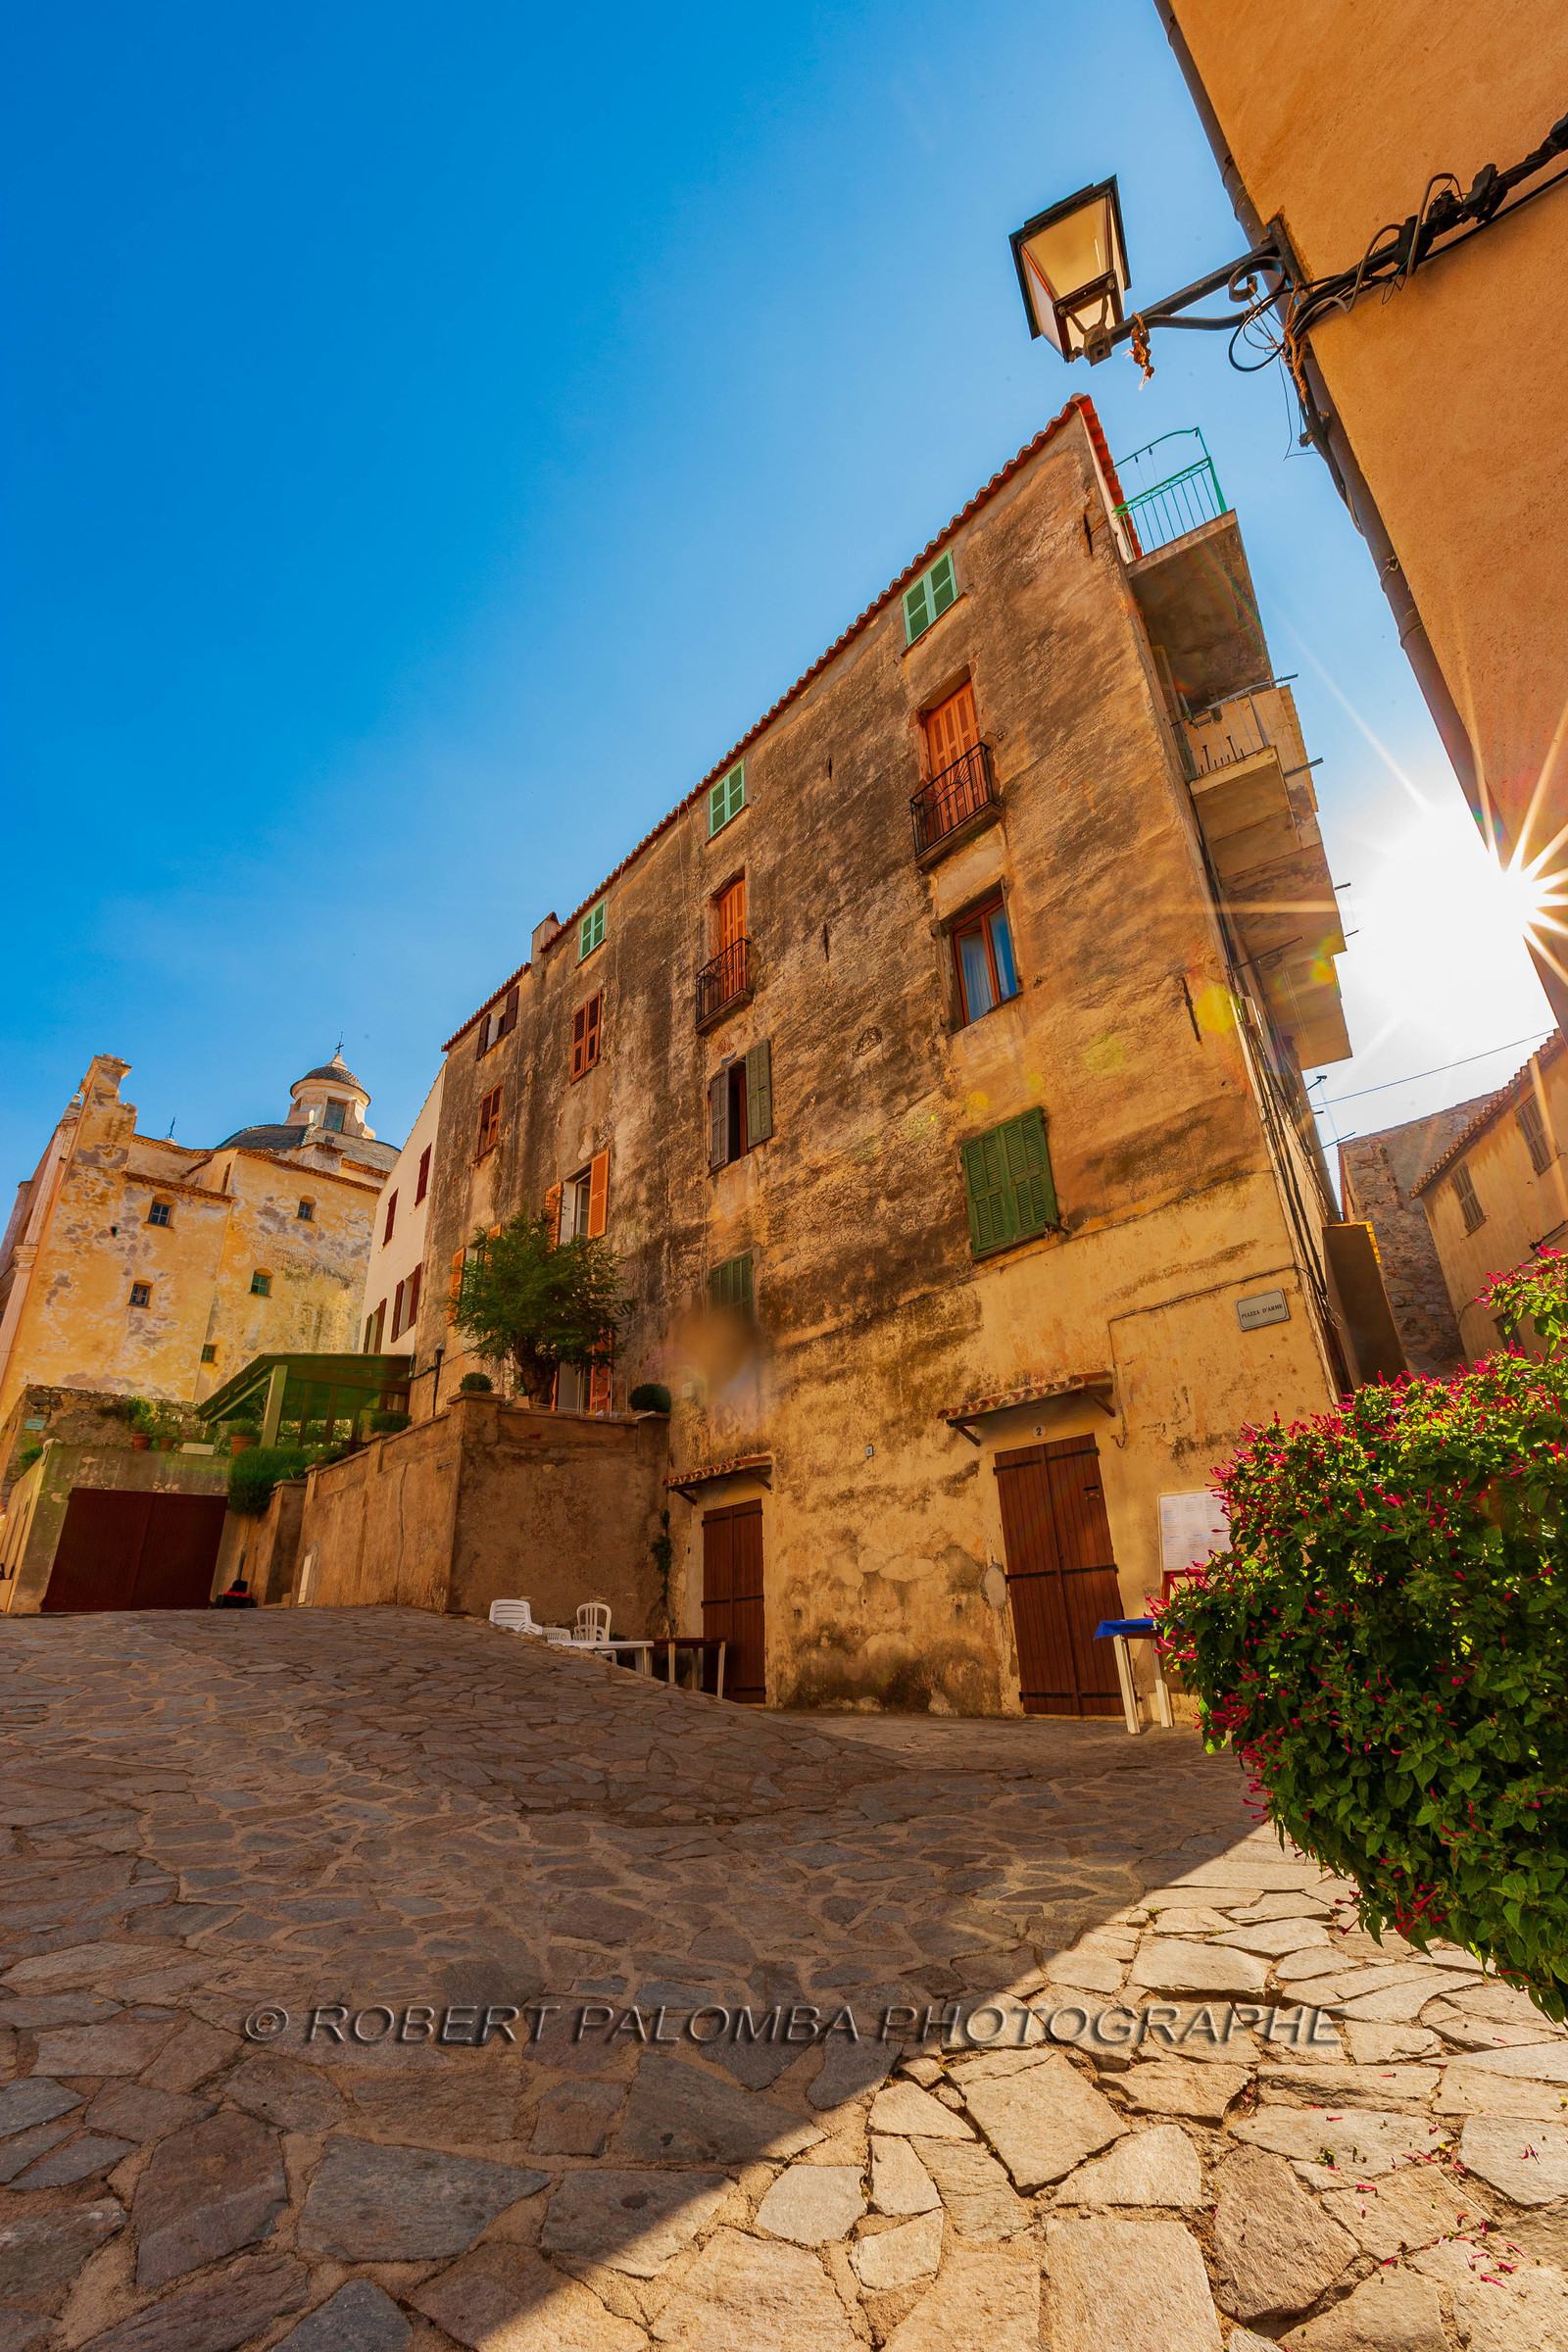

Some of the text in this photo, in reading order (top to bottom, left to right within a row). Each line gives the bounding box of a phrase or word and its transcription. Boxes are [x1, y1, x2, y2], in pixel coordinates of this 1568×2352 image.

[1241, 1303, 1283, 1319] PIAZZA D'ARME
[1036, 1426, 1042, 1436] 2
